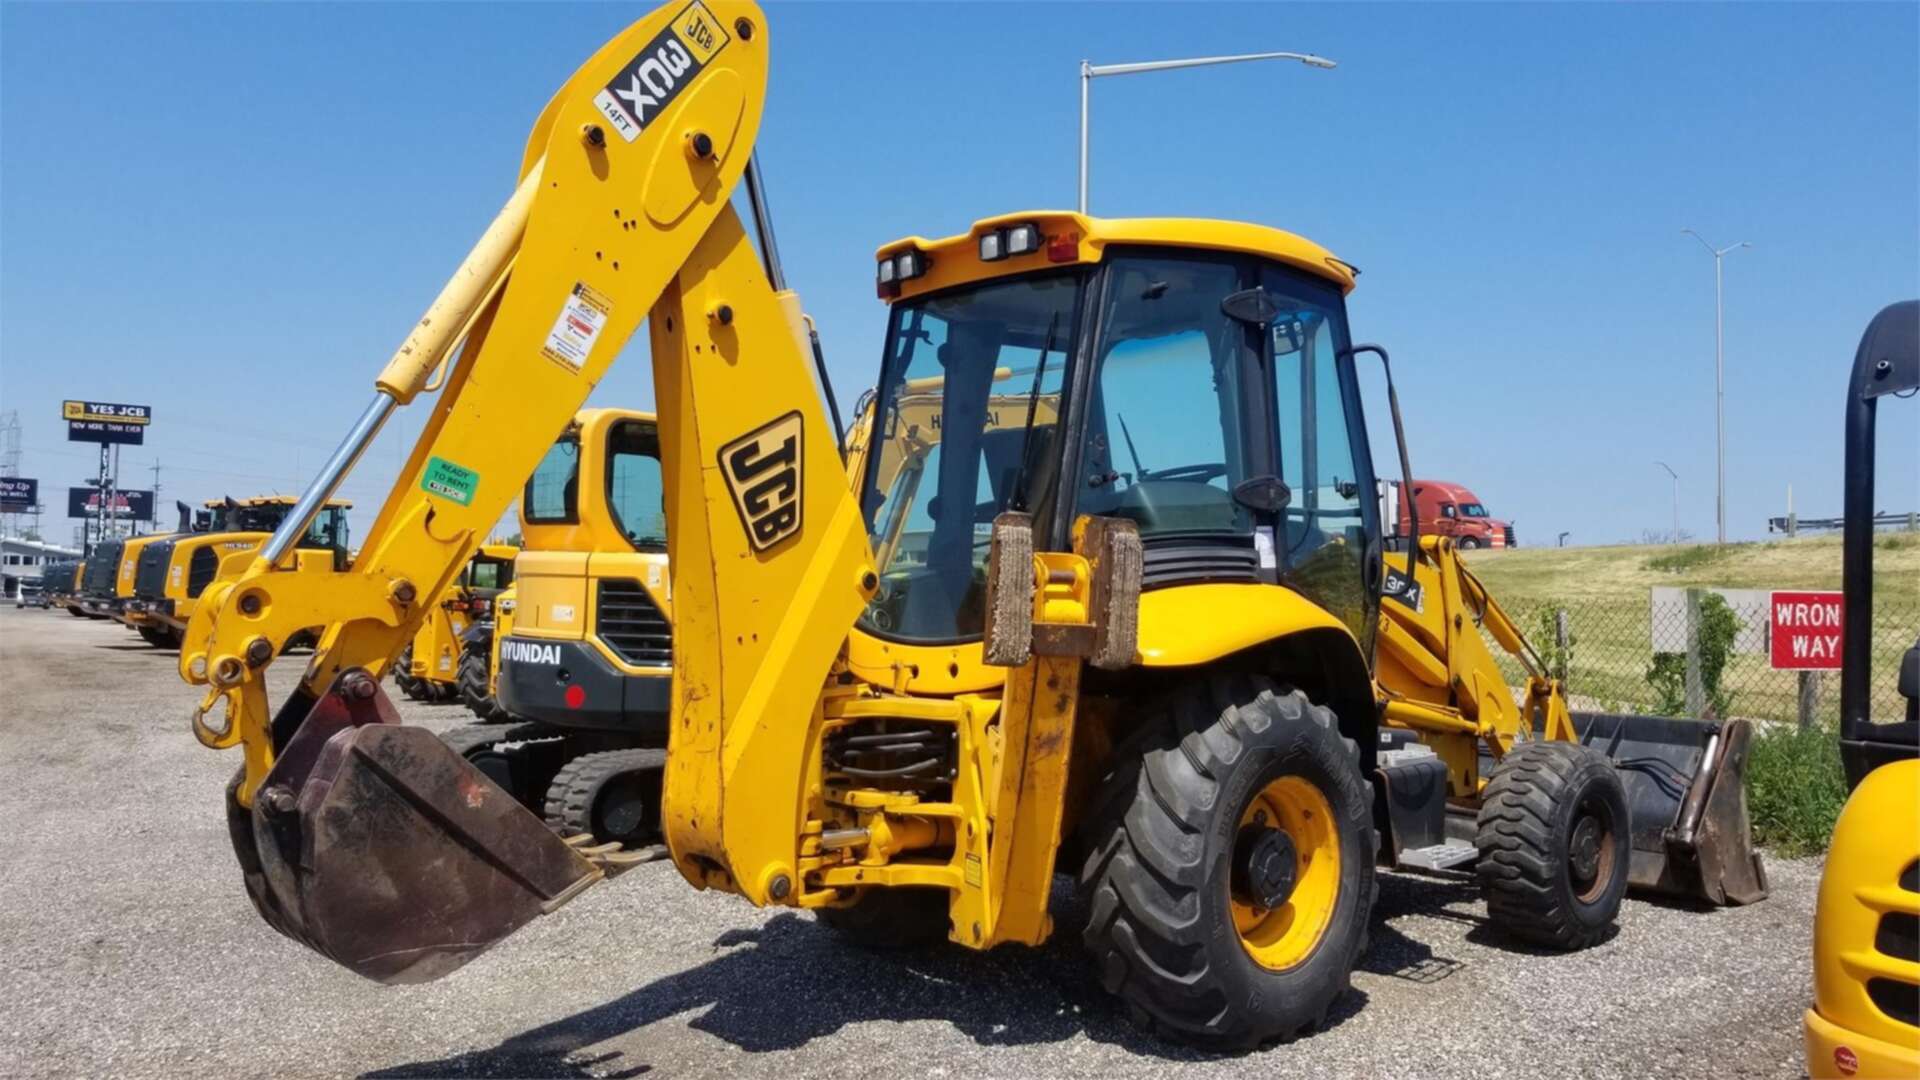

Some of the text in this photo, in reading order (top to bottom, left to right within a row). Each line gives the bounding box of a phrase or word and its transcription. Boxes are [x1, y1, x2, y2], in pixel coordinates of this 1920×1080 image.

[687, 16, 714, 50] JCB
[615, 38, 692, 122] 3CX
[603, 101, 632, 131] 14FT
[90, 404, 145, 417] YES JCB
[433, 470, 469, 490] TO RENT
[441, 463, 469, 479] READY
[730, 434, 796, 543] JCB
[1776, 603, 1840, 626] WRON
[502, 641, 561, 665] HYUNDAI
[1792, 635, 1840, 658] WAY
